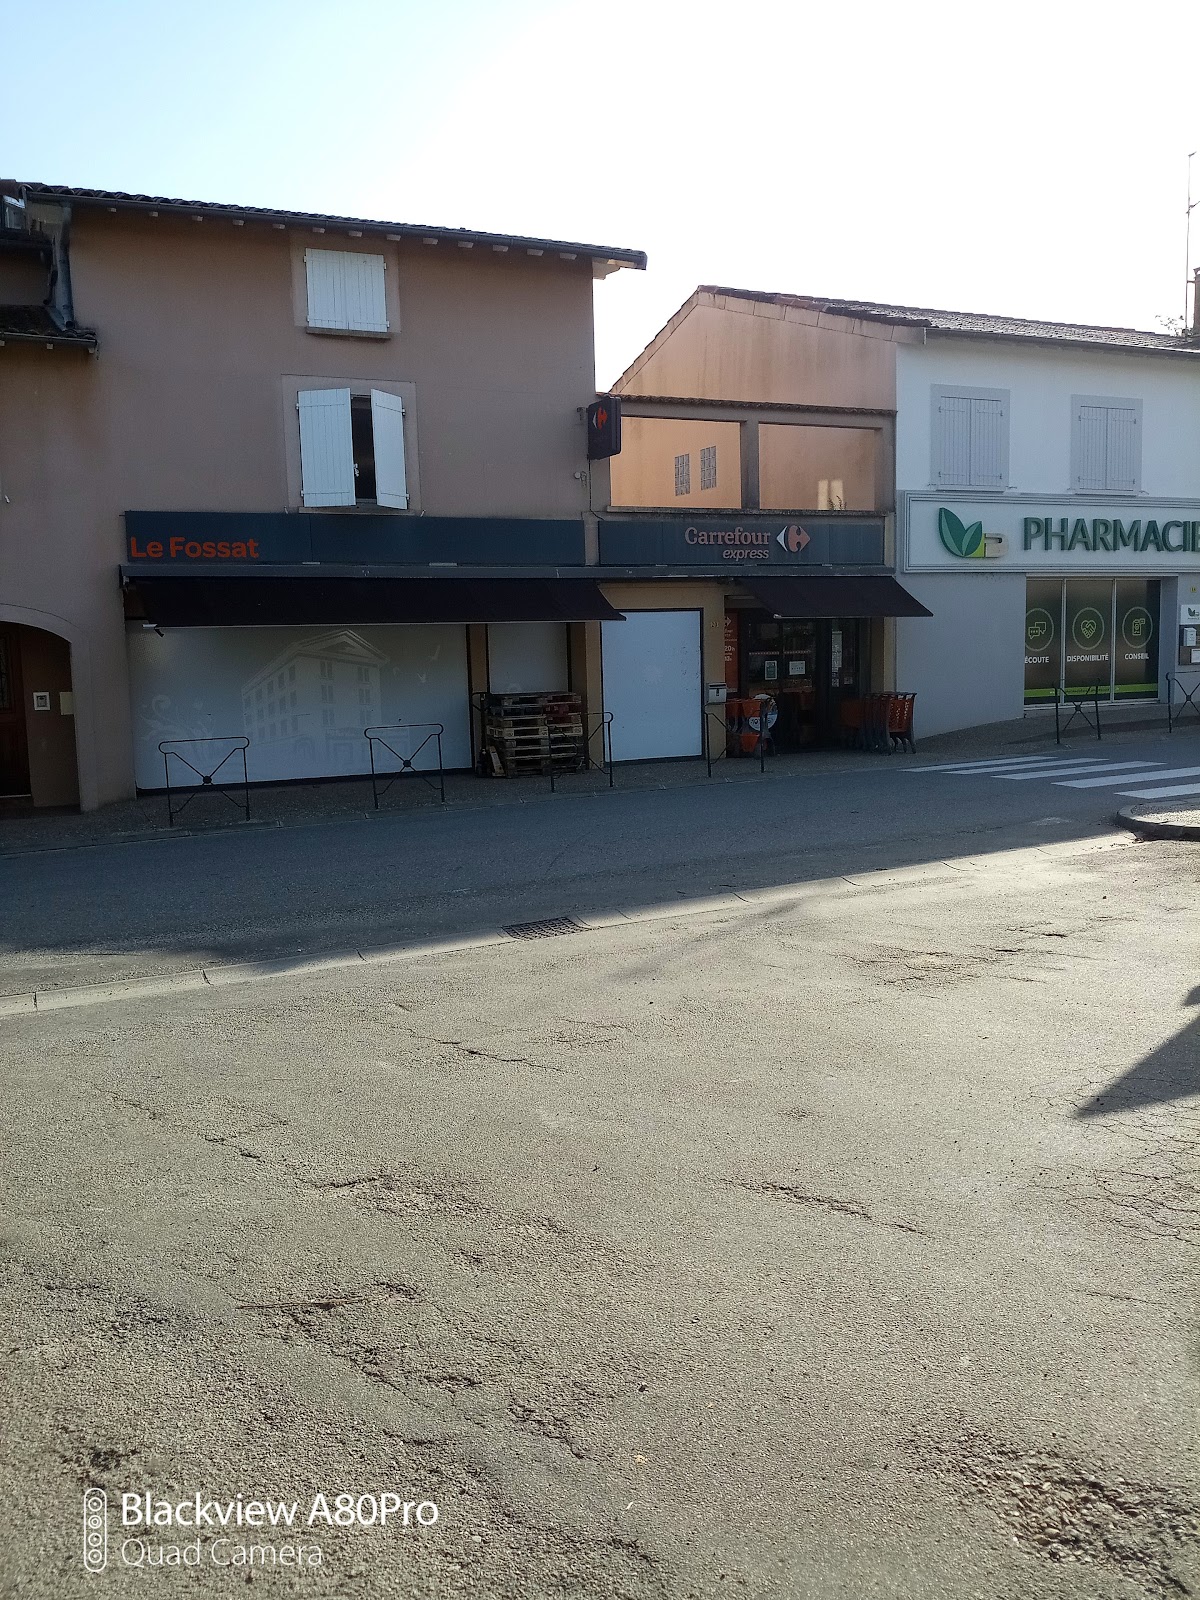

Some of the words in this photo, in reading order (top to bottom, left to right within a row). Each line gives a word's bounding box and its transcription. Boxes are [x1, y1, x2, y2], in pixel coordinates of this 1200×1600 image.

[685, 526, 771, 545] Carrefour
[1023, 516, 1200, 552] PHARMACIE
[130, 536, 163, 558] Le
[169, 536, 259, 558] Fossat
[722, 548, 770, 562] express
[1066, 652, 1109, 663] DISPONIBILITÉ
[1124, 652, 1149, 660] CONSEIL
